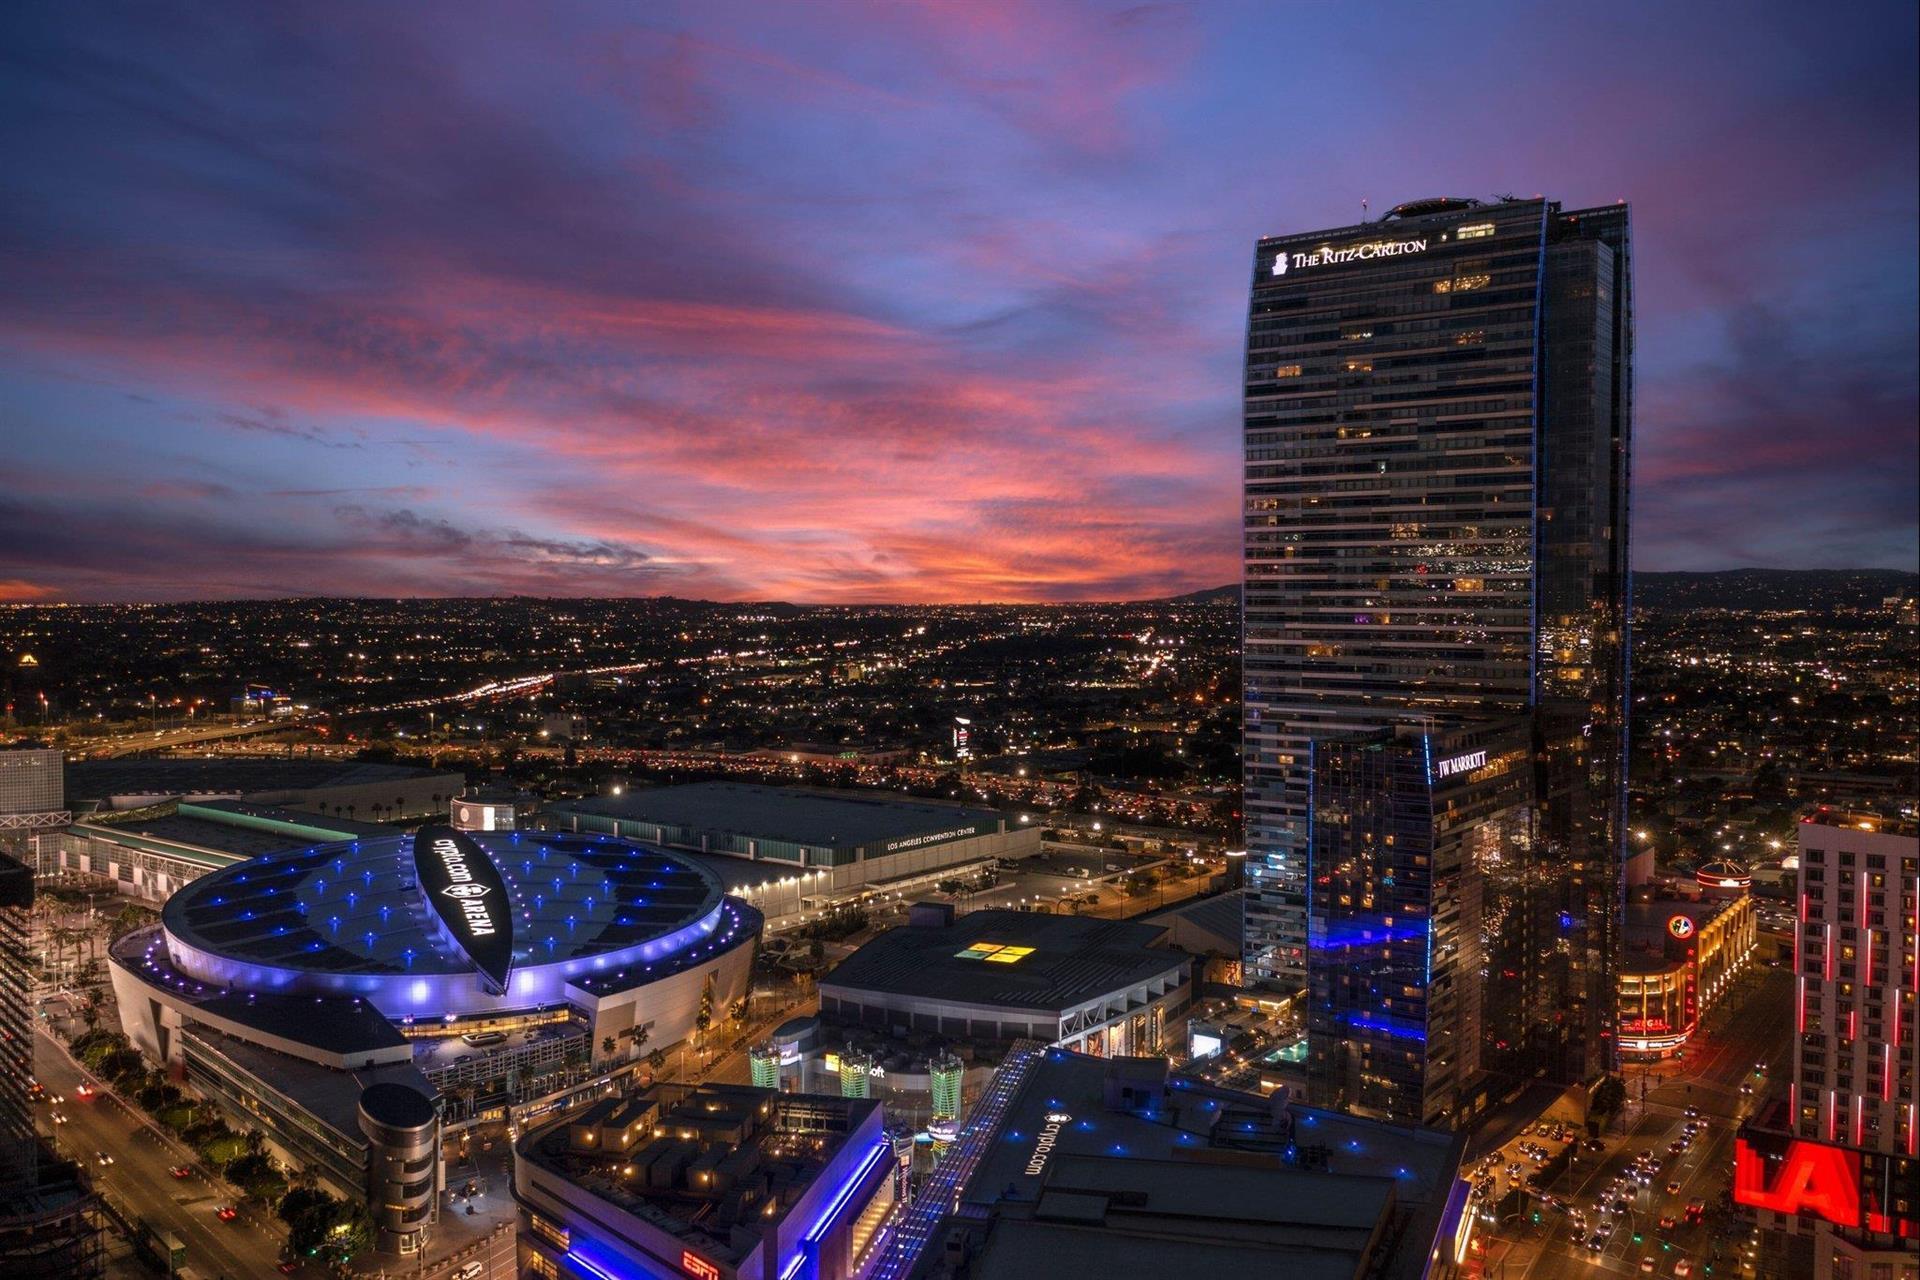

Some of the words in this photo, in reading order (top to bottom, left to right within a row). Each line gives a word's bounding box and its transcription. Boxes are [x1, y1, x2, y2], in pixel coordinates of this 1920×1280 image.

[1438, 760, 1450, 779] JW
[1450, 750, 1487, 774] MARRIOTT
[887, 842, 898, 851] LOS
[899, 837, 922, 848] ANGELES
[923, 830, 956, 844] CONVENTION
[957, 826, 976, 837] CENTER
[431, 839, 473, 883] crypto.com
[460, 899, 496, 936] ARENA
[1687, 948, 1695, 1005] REGAL
[1024, 1123, 1061, 1175] crypto.com
[1734, 1138, 1860, 1228] LA
[683, 1251, 719, 1280] ESPN
